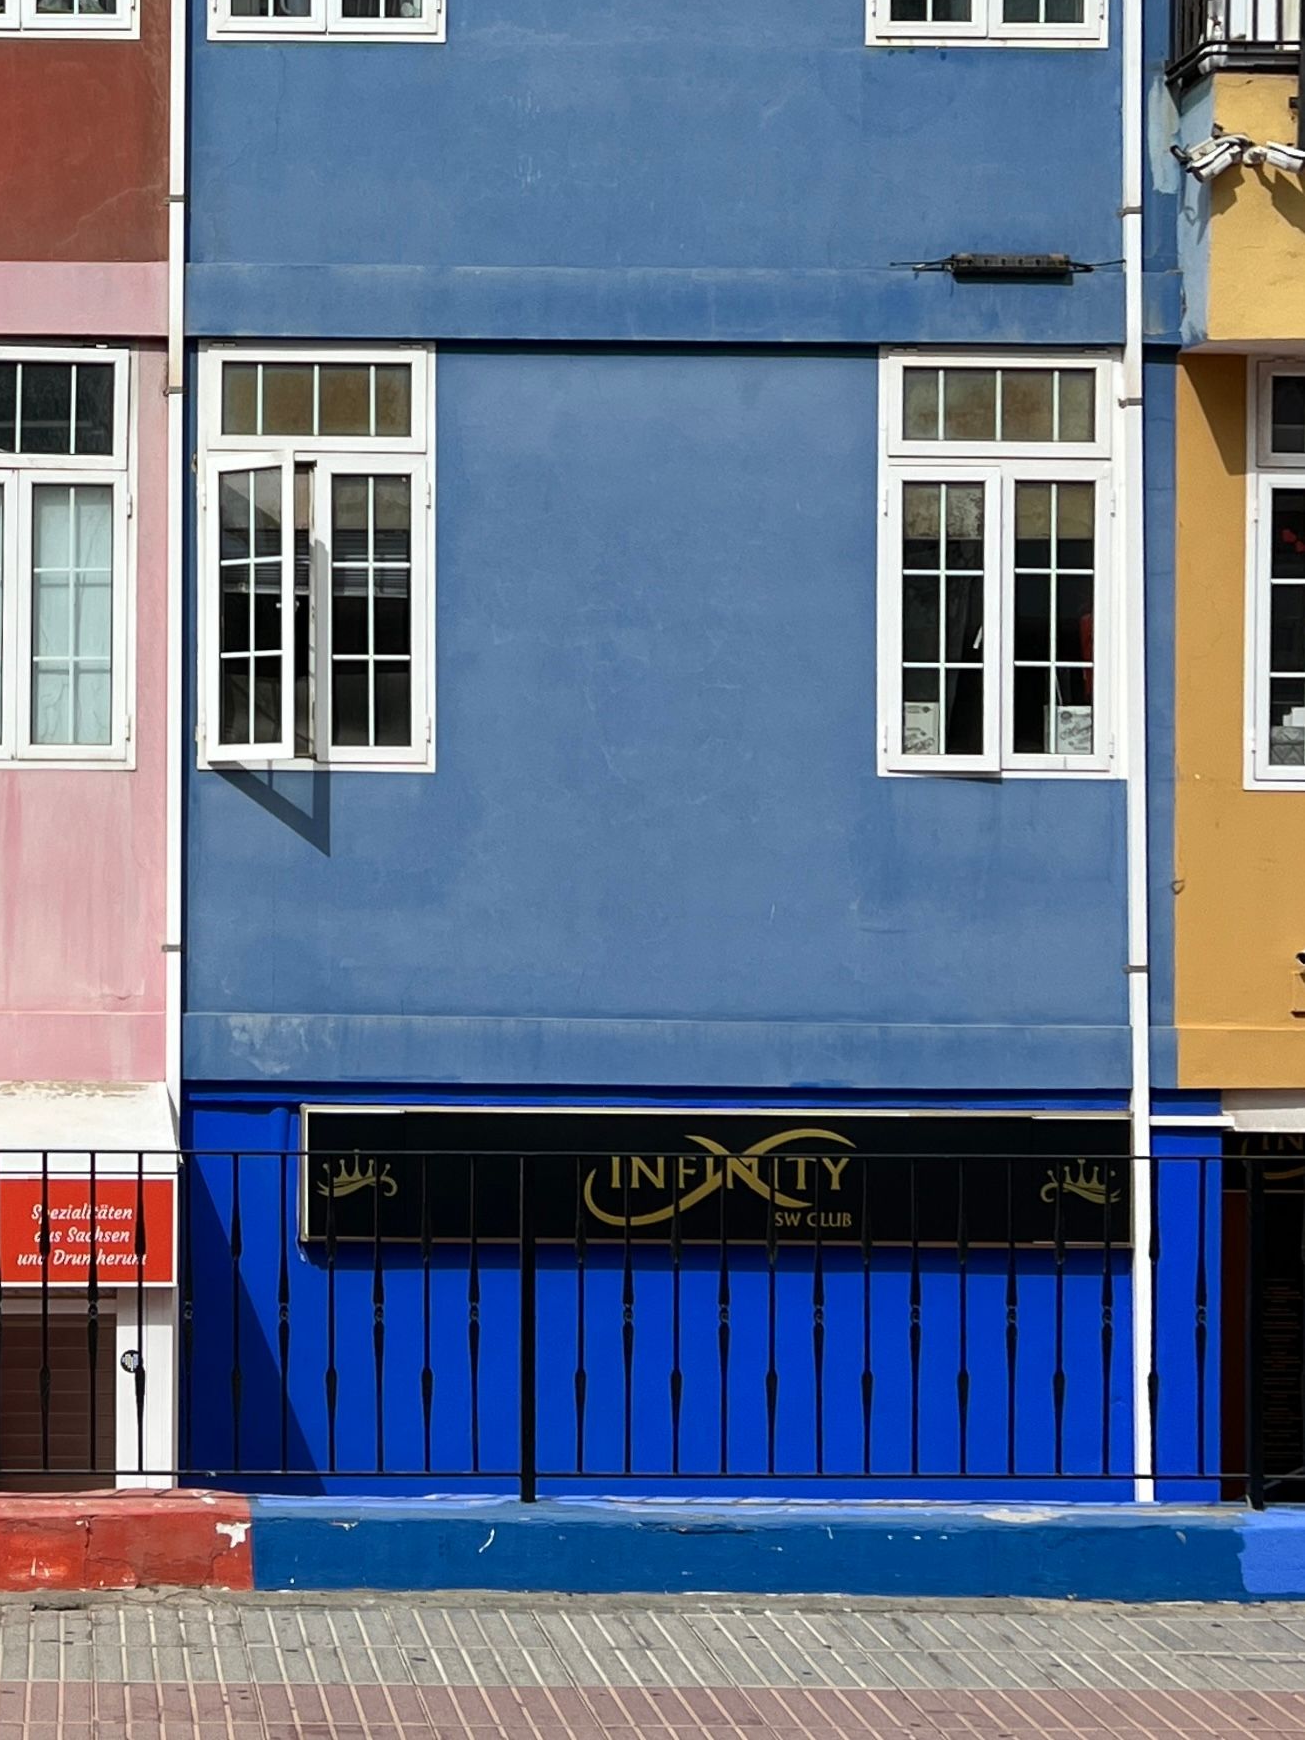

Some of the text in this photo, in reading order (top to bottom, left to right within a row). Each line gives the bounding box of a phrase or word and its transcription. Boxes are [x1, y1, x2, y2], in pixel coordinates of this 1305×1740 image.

[611, 1154, 850, 1191] INFINITY
[774, 1212, 853, 1228] SW CLUB
